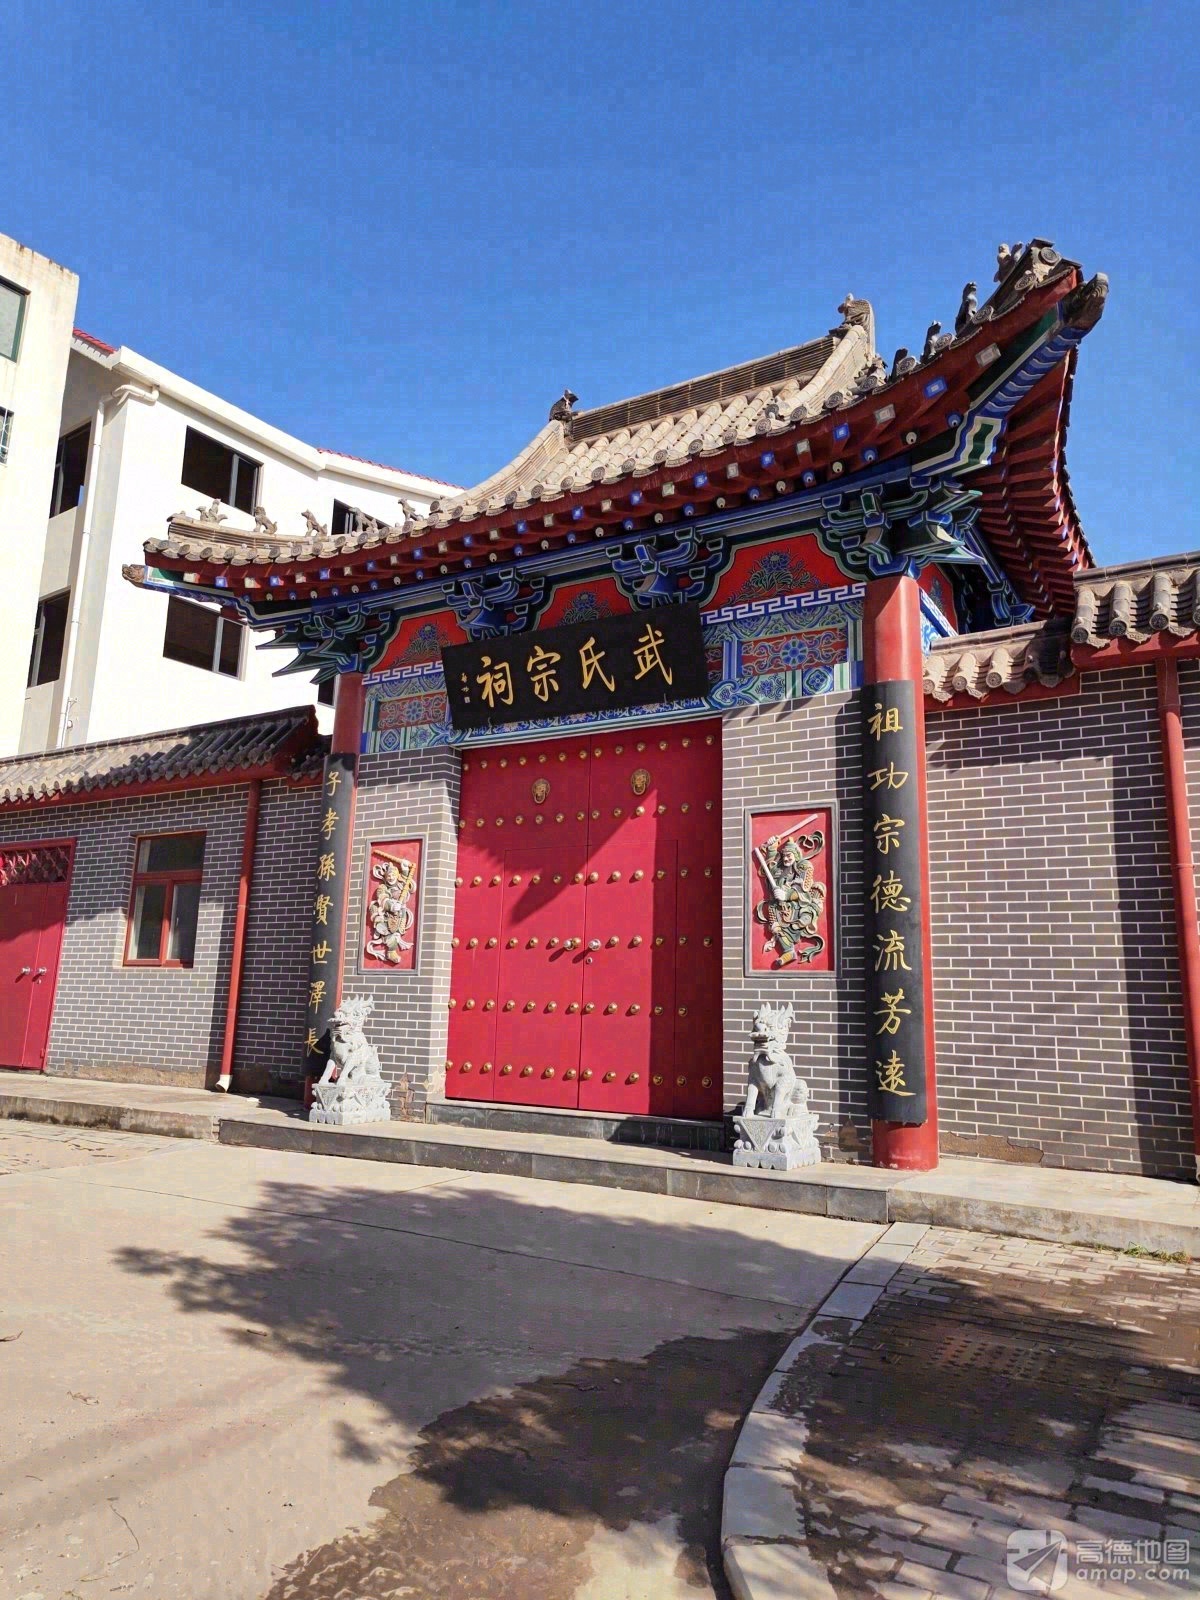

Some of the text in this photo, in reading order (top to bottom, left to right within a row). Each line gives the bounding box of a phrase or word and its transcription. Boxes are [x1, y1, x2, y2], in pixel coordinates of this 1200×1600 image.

[476, 623, 673, 708] 武氏宗祠
[867, 702, 916, 1097] 祖功宗德流芳遠
